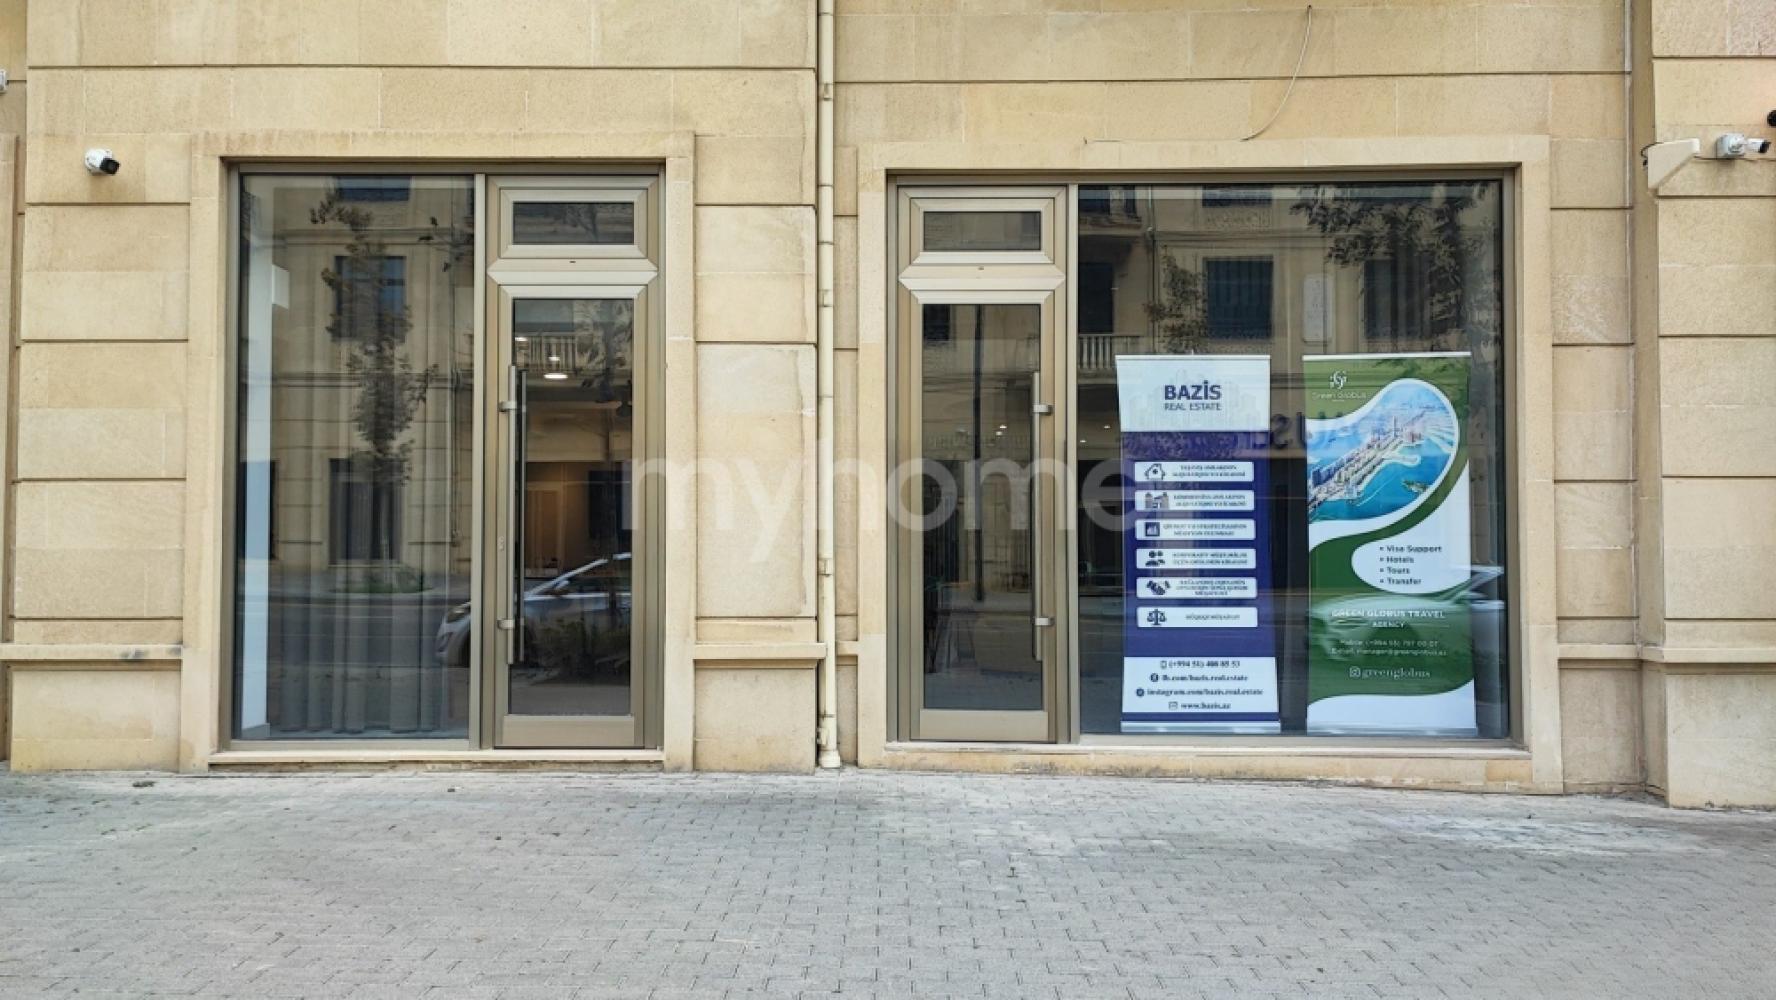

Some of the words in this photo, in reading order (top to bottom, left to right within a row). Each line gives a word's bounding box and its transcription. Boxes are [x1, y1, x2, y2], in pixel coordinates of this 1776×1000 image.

[1164, 379, 1222, 401] BAZİS
[1164, 402, 1187, 411] REAL
[1189, 402, 1222, 411] ESTATE
[1386, 545, 1405, 553] Visa
[1406, 545, 1442, 554] Support
[1386, 556, 1415, 564] Hotels
[1386, 567, 1411, 575] Tours
[1386, 577, 1422, 585] Transfer
[1331, 608, 1365, 618] GREEN
[1407, 610, 1445, 619] TRAVEL
